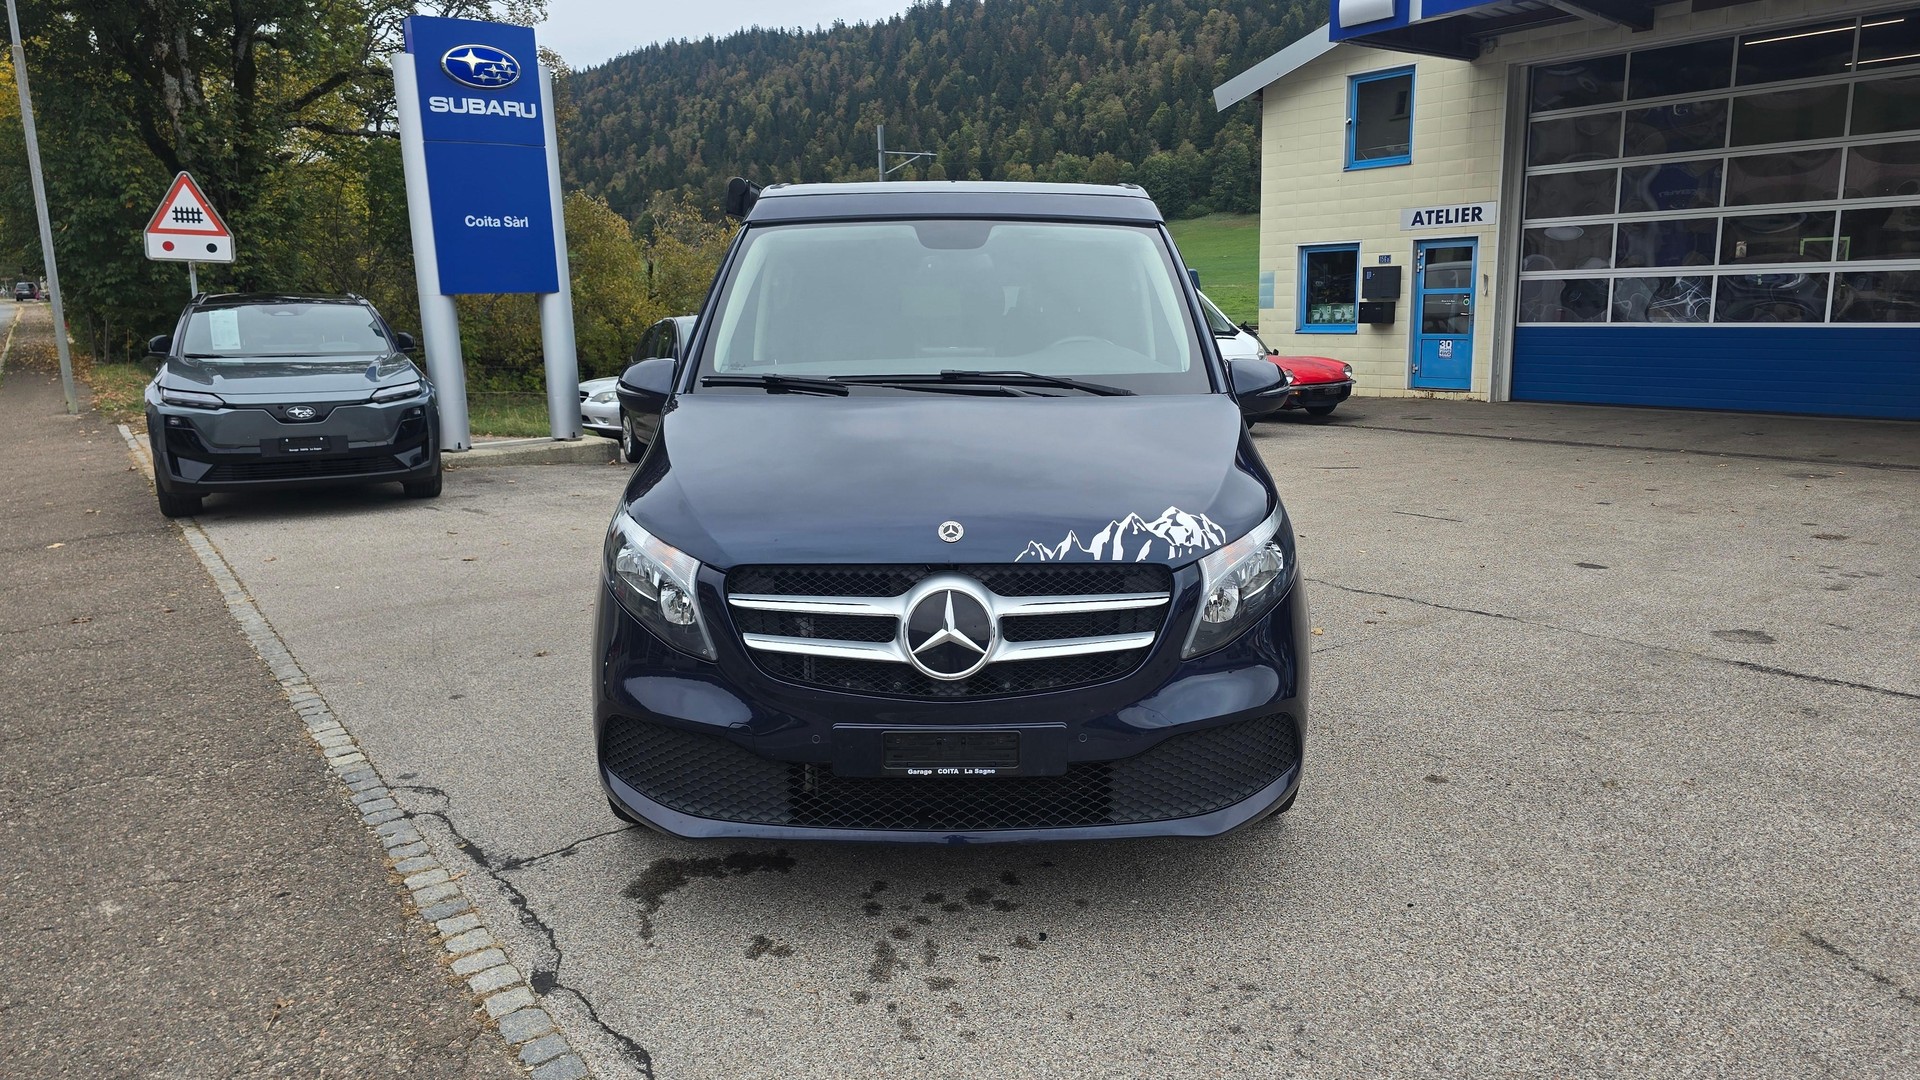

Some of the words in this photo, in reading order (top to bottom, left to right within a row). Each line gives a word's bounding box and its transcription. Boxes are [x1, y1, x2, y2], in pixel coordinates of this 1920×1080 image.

[429, 96, 537, 119] SUBARU
[465, 215, 501, 227] Coita
[503, 216, 529, 228] Sàrl
[1411, 206, 1483, 226] ATELIER
[907, 768, 933, 776] Garage
